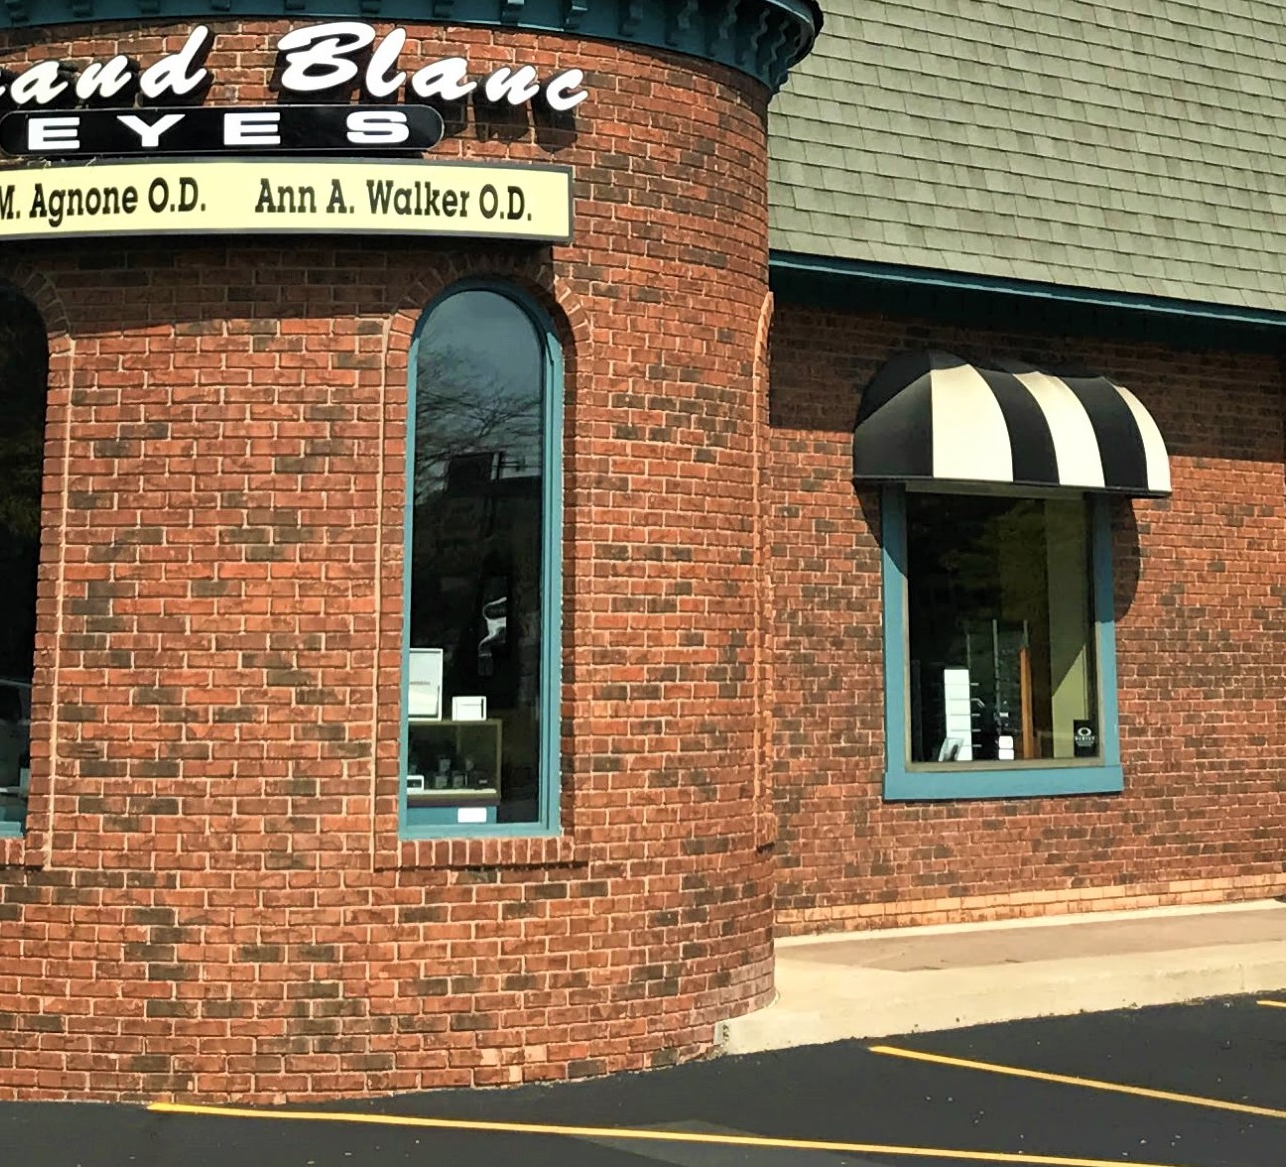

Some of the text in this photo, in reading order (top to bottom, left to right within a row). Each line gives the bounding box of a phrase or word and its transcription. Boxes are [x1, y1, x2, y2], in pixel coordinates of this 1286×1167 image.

[277, 21, 589, 111] Blanc
[27, 111, 410, 151] EYES
[28, 183, 139, 228] Agnone
[148, 176, 207, 213] O.D.
[254, 178, 533, 221] Ann A. Walker O.D.
